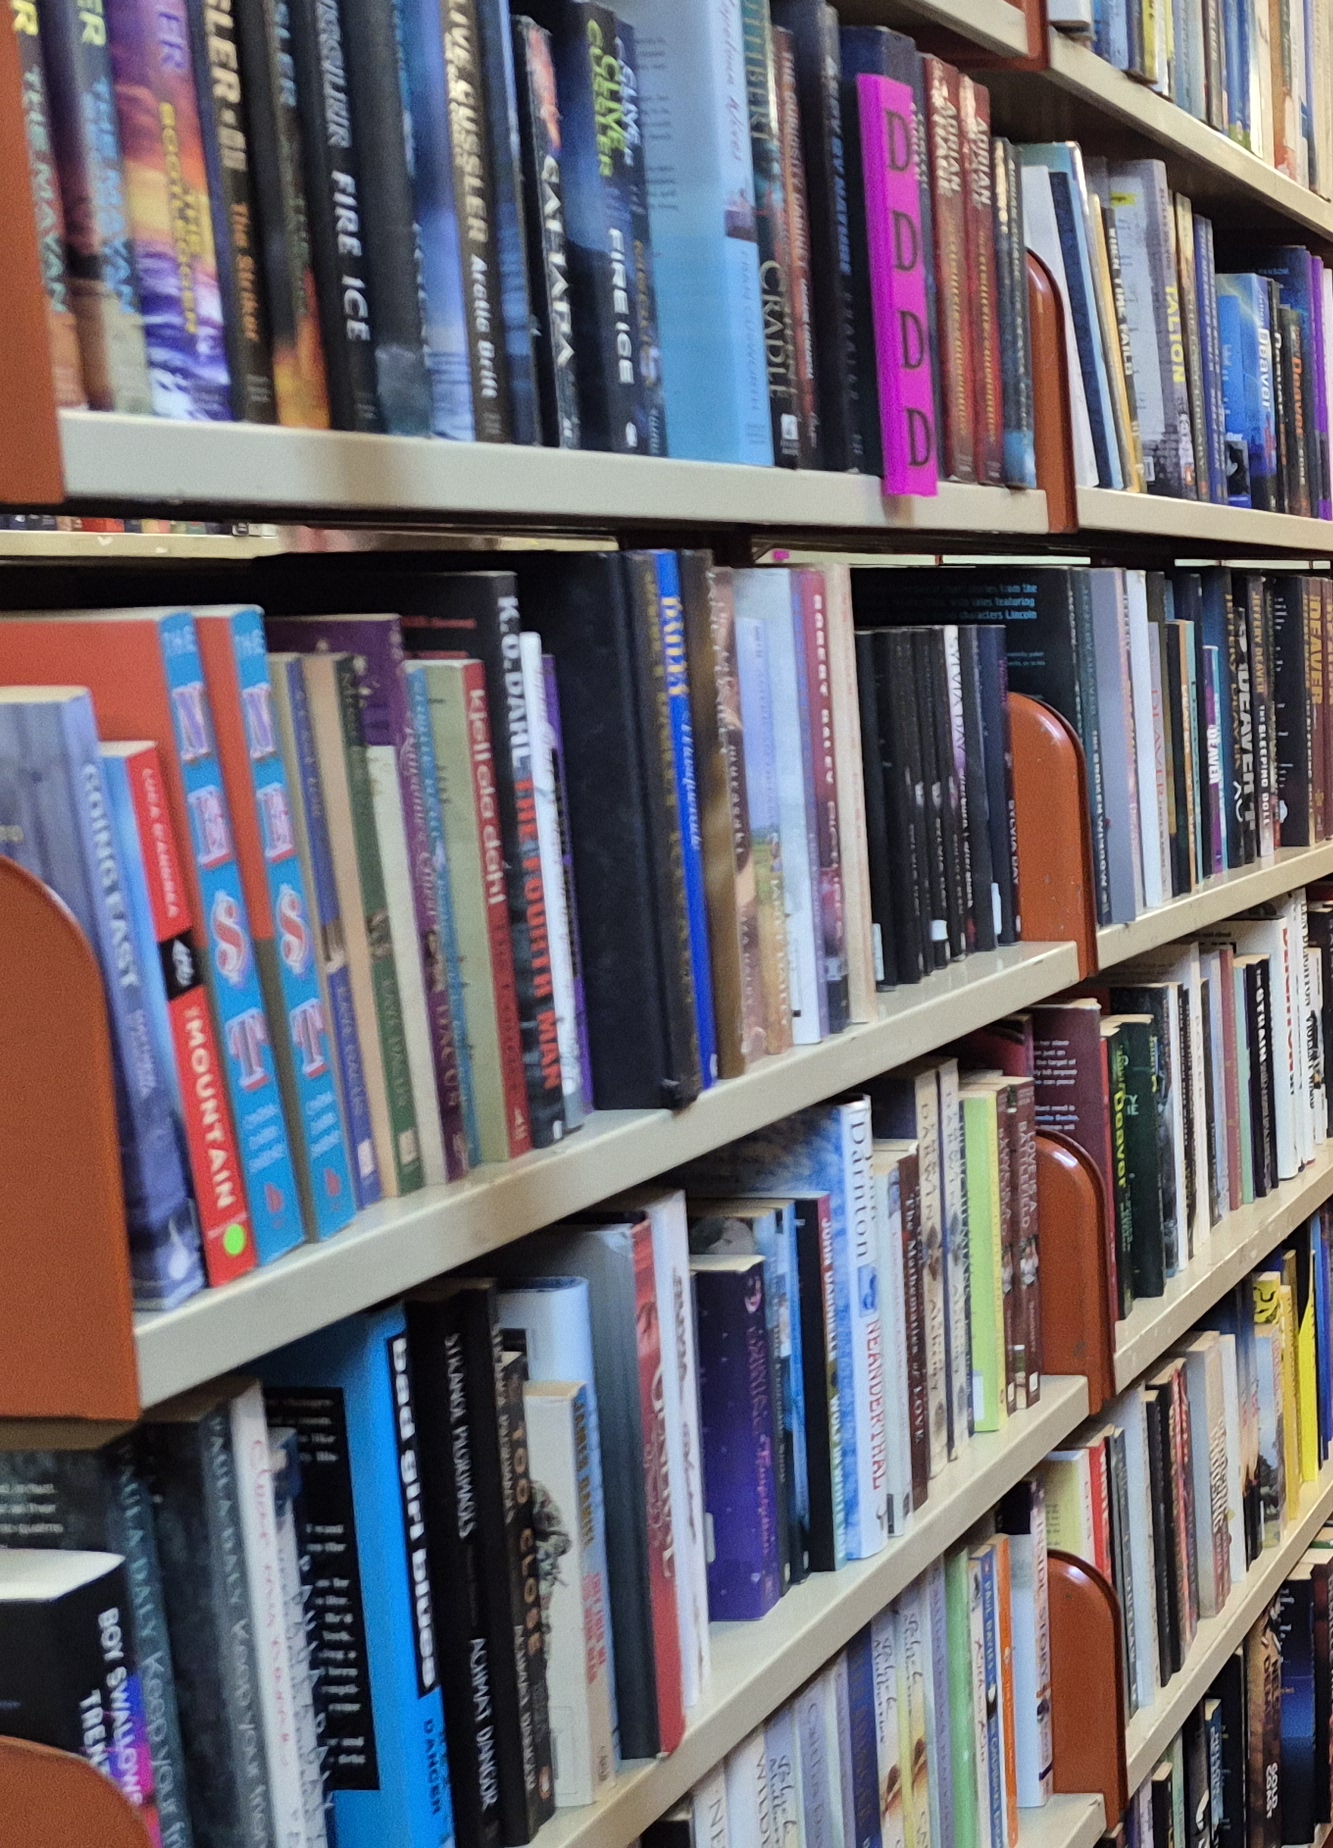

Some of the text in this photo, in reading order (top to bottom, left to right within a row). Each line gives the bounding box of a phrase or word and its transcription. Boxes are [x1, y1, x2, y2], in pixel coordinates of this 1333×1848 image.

[331, 171, 363, 257] FIRE
[342, 276, 371, 342] ICE
[470, 253, 499, 399] Arctic Drift
[607, 227, 635, 386] FIRE ICE
[885, 110, 932, 467] D D D D
[1165, 283, 1185, 384] TALION
[1258, 327, 1272, 410] Deaver
[1005, 609, 1038, 619] Lincoln
[1022, 583, 1038, 593] the
[1252, 591, 1266, 693] JEFFERY DEAVER
[1308, 596, 1324, 705] DEAVER
[953, 713, 967, 753] DAY
[1151, 689, 1166, 797] DEAVER
[1207, 724, 1221, 785] DEAVER
[1258, 723, 1271, 826] SLEEPING DOLL
[81, 763, 143, 989] GOING EAST
[1097, 817, 1108, 887] WINDOW
[535, 1009, 563, 1091] MAN
[1255, 987, 1268, 1062] STRAIN
[187, 1018, 236, 1209] MOUNTAIN
[1113, 1090, 1127, 1188] Deaver
[850, 1119, 872, 1259] Darnton
[821, 1217, 833, 1267] JOHN
[865, 1320, 888, 1491] NEANDERTHAL
[912, 1387, 925, 1444] LOVE
[391, 1338, 438, 1691] bad girl blues
[98, 1606, 124, 1661] BOY
[1039, 1614, 1050, 1682] STORY
[469, 1637, 499, 1812] ACHMAT DANGOR
[1264, 1763, 1275, 1819] COAST
[1268, 1762, 1278, 1810] GOLD
